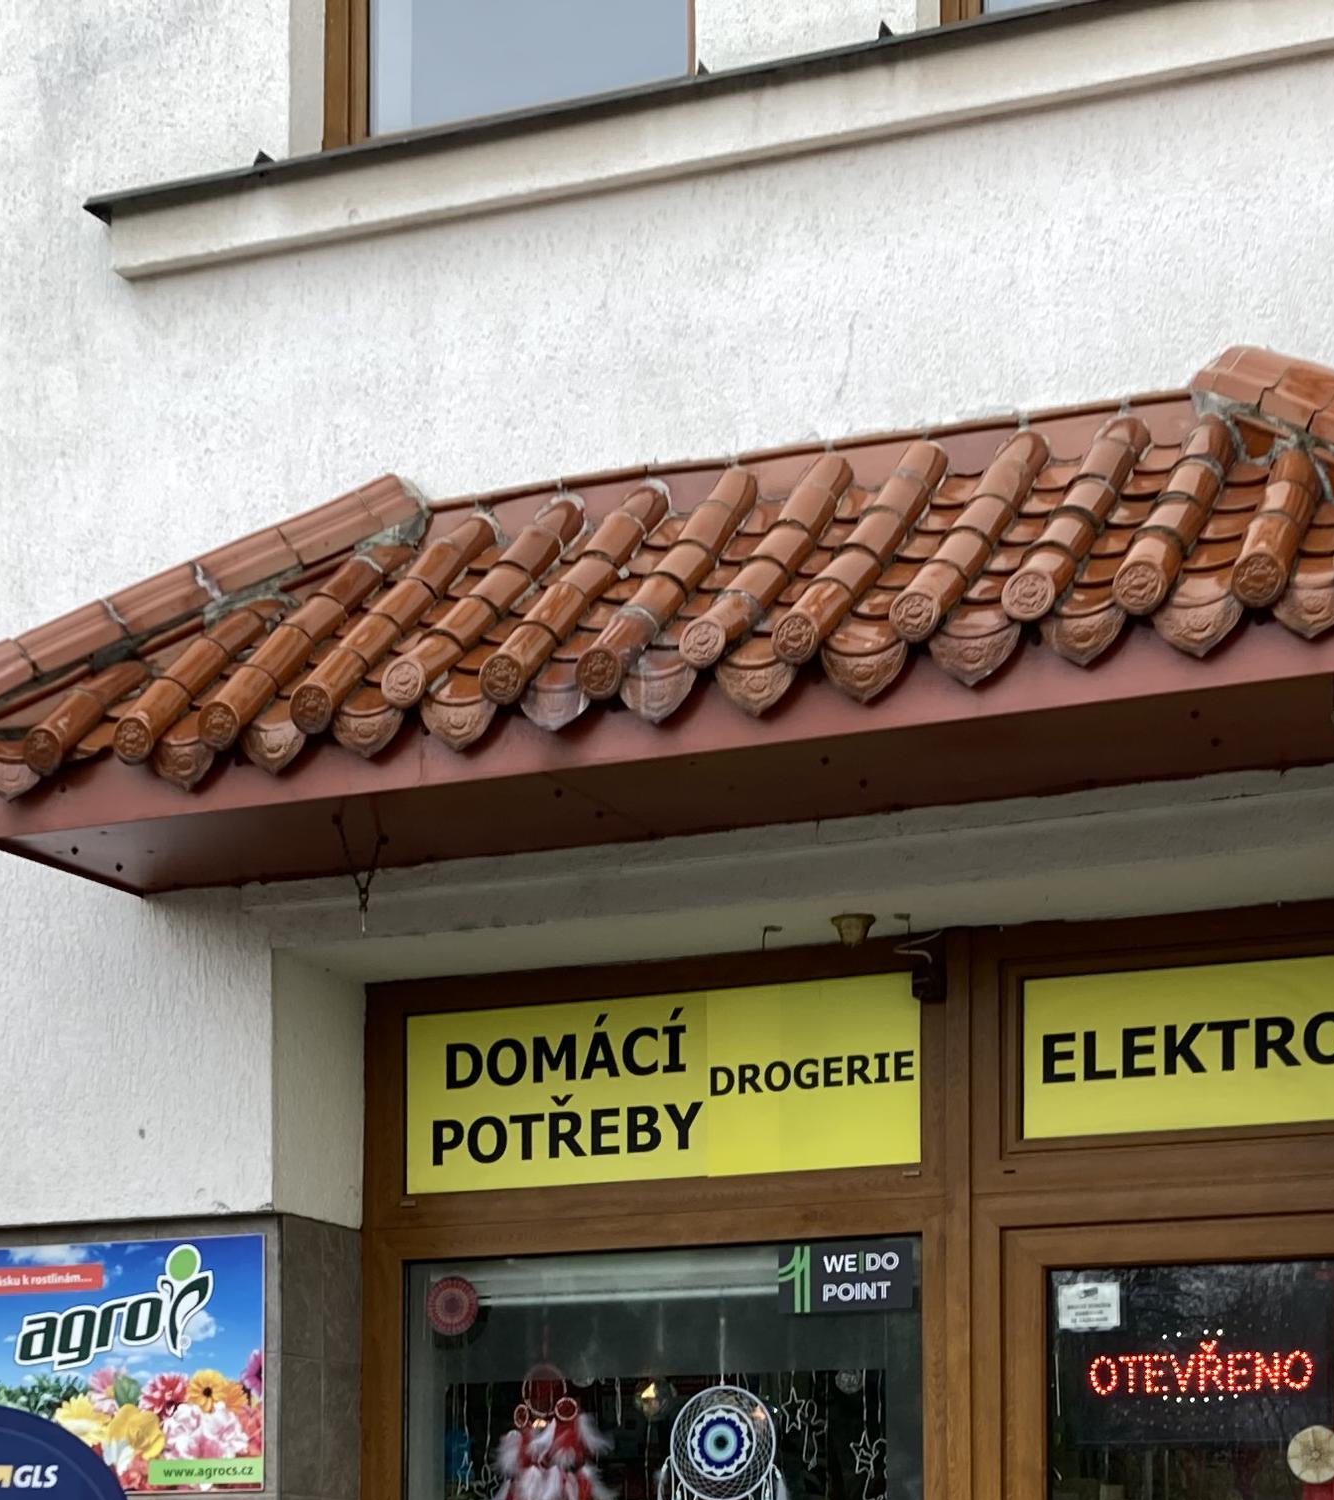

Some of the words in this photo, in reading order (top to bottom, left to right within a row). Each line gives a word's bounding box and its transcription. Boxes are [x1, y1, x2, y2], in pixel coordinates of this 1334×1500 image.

[444, 1007, 688, 1090] DOMÁCÍ
[708, 1049, 915, 1097] DROGERIE
[430, 1094, 704, 1167] POTŘEBY
[22, 1274, 29, 1285] k
[822, 1281, 892, 1302] POINT
[1088, 1338, 1315, 1396] OTEVŘENO
[12, 1464, 59, 1489] GLS
[163, 1466, 254, 1480] www.agrocs.cz
